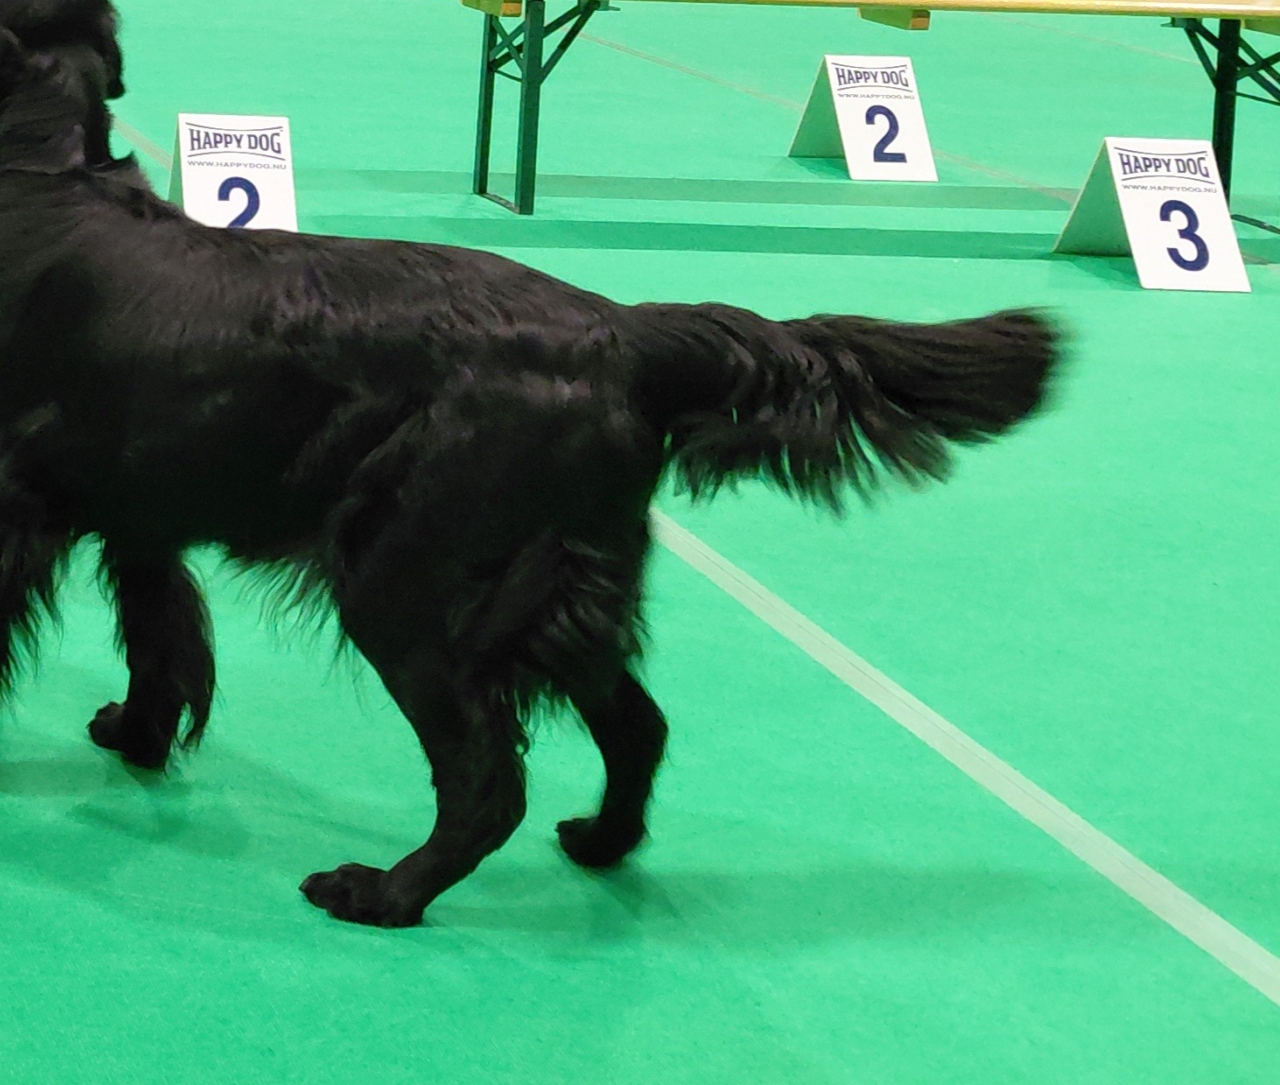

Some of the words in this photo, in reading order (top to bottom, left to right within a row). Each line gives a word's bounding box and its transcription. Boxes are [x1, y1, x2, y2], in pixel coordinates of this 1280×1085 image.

[835, 67, 878, 86] HAPPY
[880, 69, 909, 87] DOG
[189, 128, 244, 151] HAPPY
[246, 132, 282, 154] DOG
[865, 104, 907, 163] 2
[187, 160, 287, 170] WWW.HAPPYDOG.NU
[1118, 152, 1171, 175] HAPPY
[1174, 156, 1210, 178] DOG
[217, 176, 260, 229] 2
[1159, 199, 1210, 272] 3
